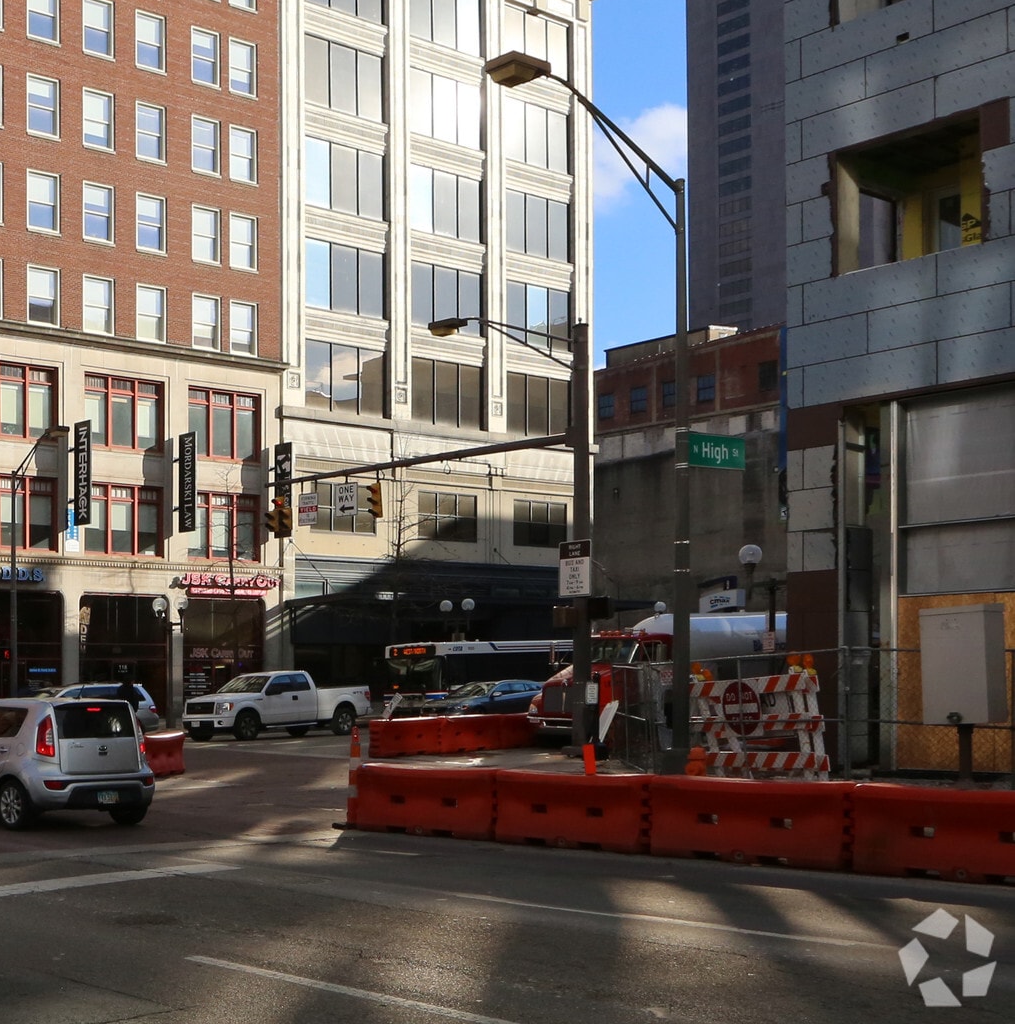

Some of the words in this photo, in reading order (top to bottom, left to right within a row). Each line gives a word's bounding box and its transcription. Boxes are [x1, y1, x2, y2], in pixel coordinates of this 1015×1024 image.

[693, 444, 699, 453] N
[702, 441, 729, 464] High
[732, 448, 739, 457] St
[78, 426, 88, 519] INTERHACK
[184, 436, 193, 501] MORDARSKI
[338, 485, 354, 494] ONE
[338, 495, 354, 503] WAY
[184, 504, 193, 529] LAW
[189, 647, 209, 658] JSK
[725, 692, 736, 702] DO
